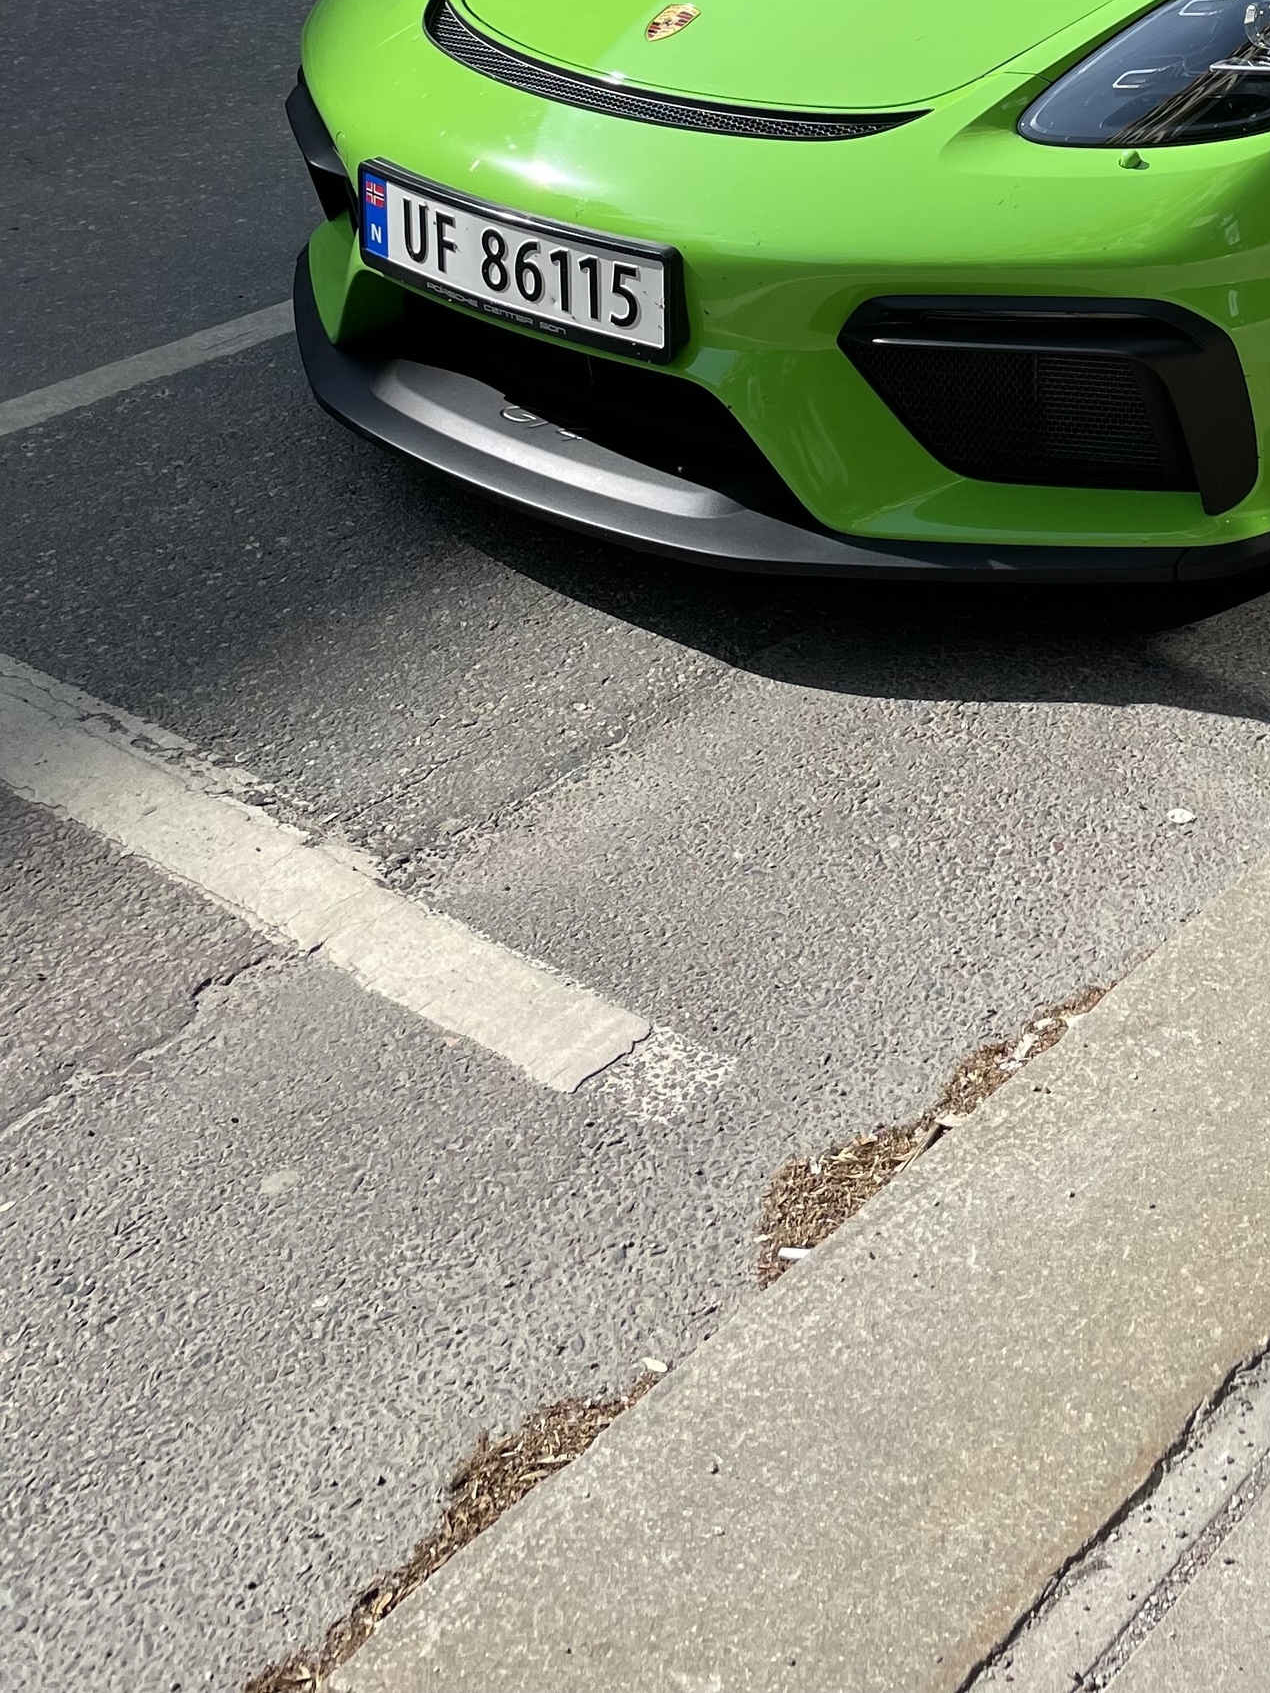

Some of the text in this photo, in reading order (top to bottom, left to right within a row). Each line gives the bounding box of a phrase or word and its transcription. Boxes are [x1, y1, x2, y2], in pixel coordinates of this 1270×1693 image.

[369, 222, 383, 245] N
[401, 195, 642, 329] UF 86115
[426, 281, 479, 309] PORSCHE
[483, 303, 534, 326] CENTER
